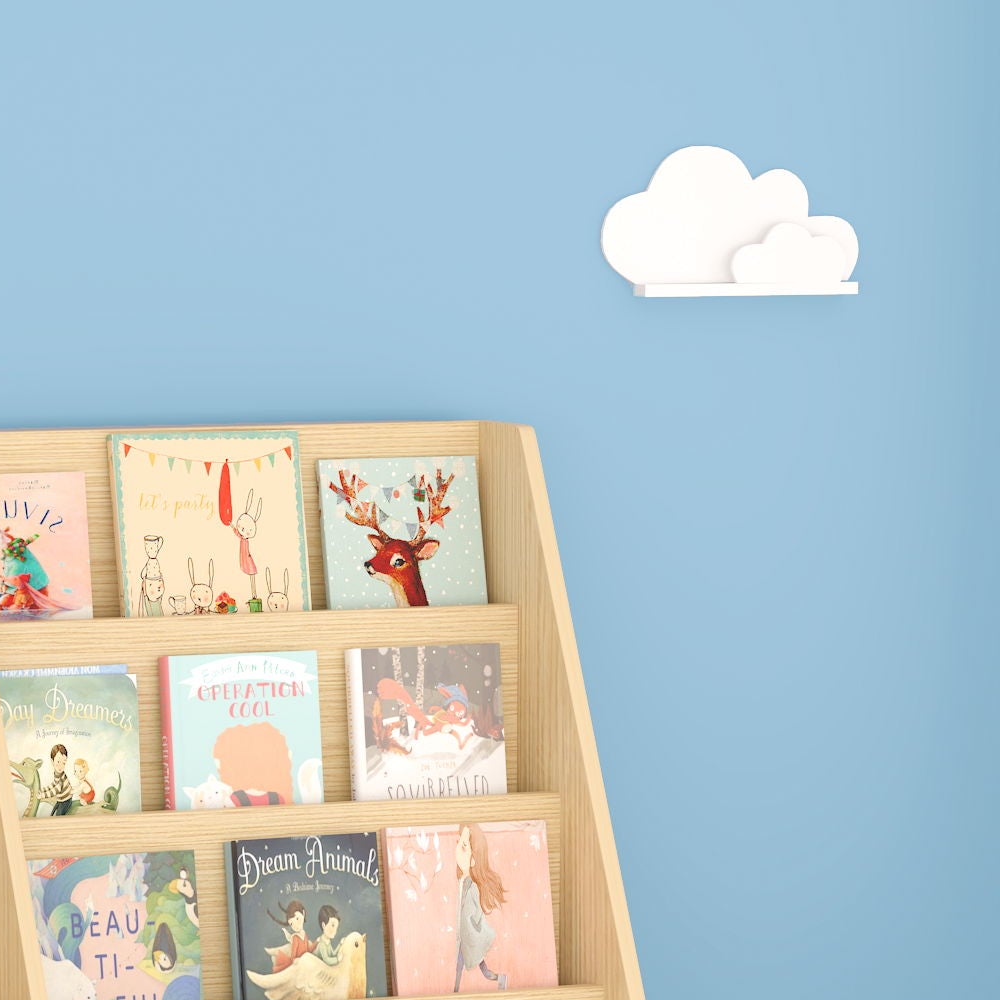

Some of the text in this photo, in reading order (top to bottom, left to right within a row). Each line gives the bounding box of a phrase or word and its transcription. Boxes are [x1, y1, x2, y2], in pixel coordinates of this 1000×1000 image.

[138, 492, 215, 519] let's party
[197, 681, 305, 701] OPERATION
[43, 682, 133, 733] Dreamers
[229, 700, 276, 719] COOL
[237, 835, 379, 896] Dream Animals
